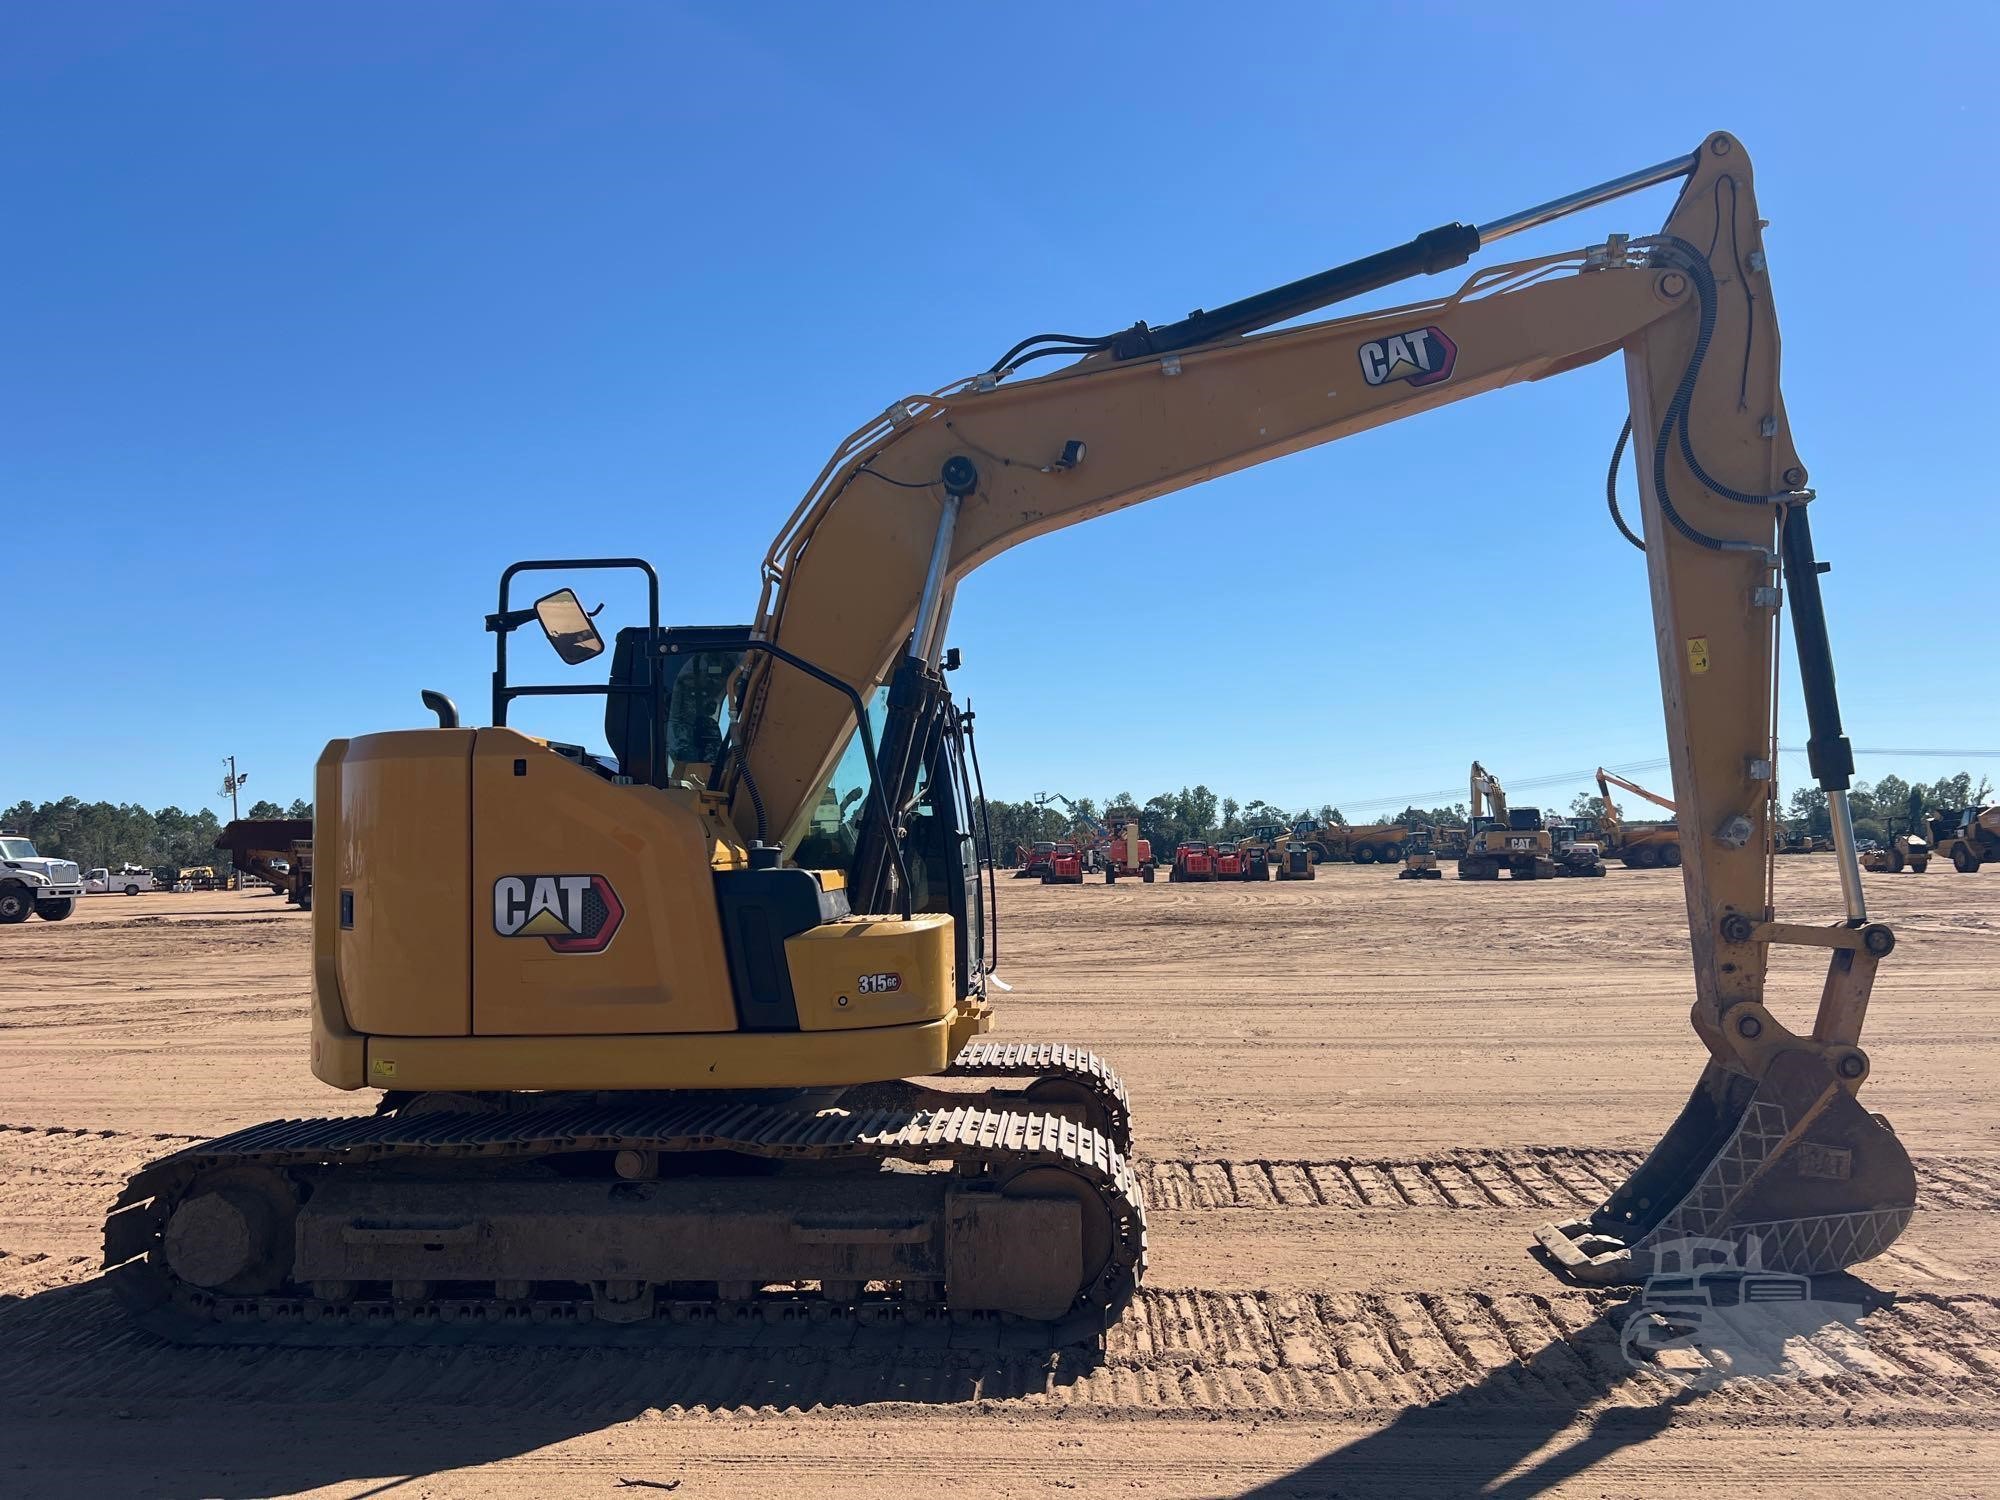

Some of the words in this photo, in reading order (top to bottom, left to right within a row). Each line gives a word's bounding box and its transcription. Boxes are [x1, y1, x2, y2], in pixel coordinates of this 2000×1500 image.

[1360, 329, 1430, 385] CAT
[1511, 838, 1531, 850] CAT
[494, 876, 591, 935] CAT
